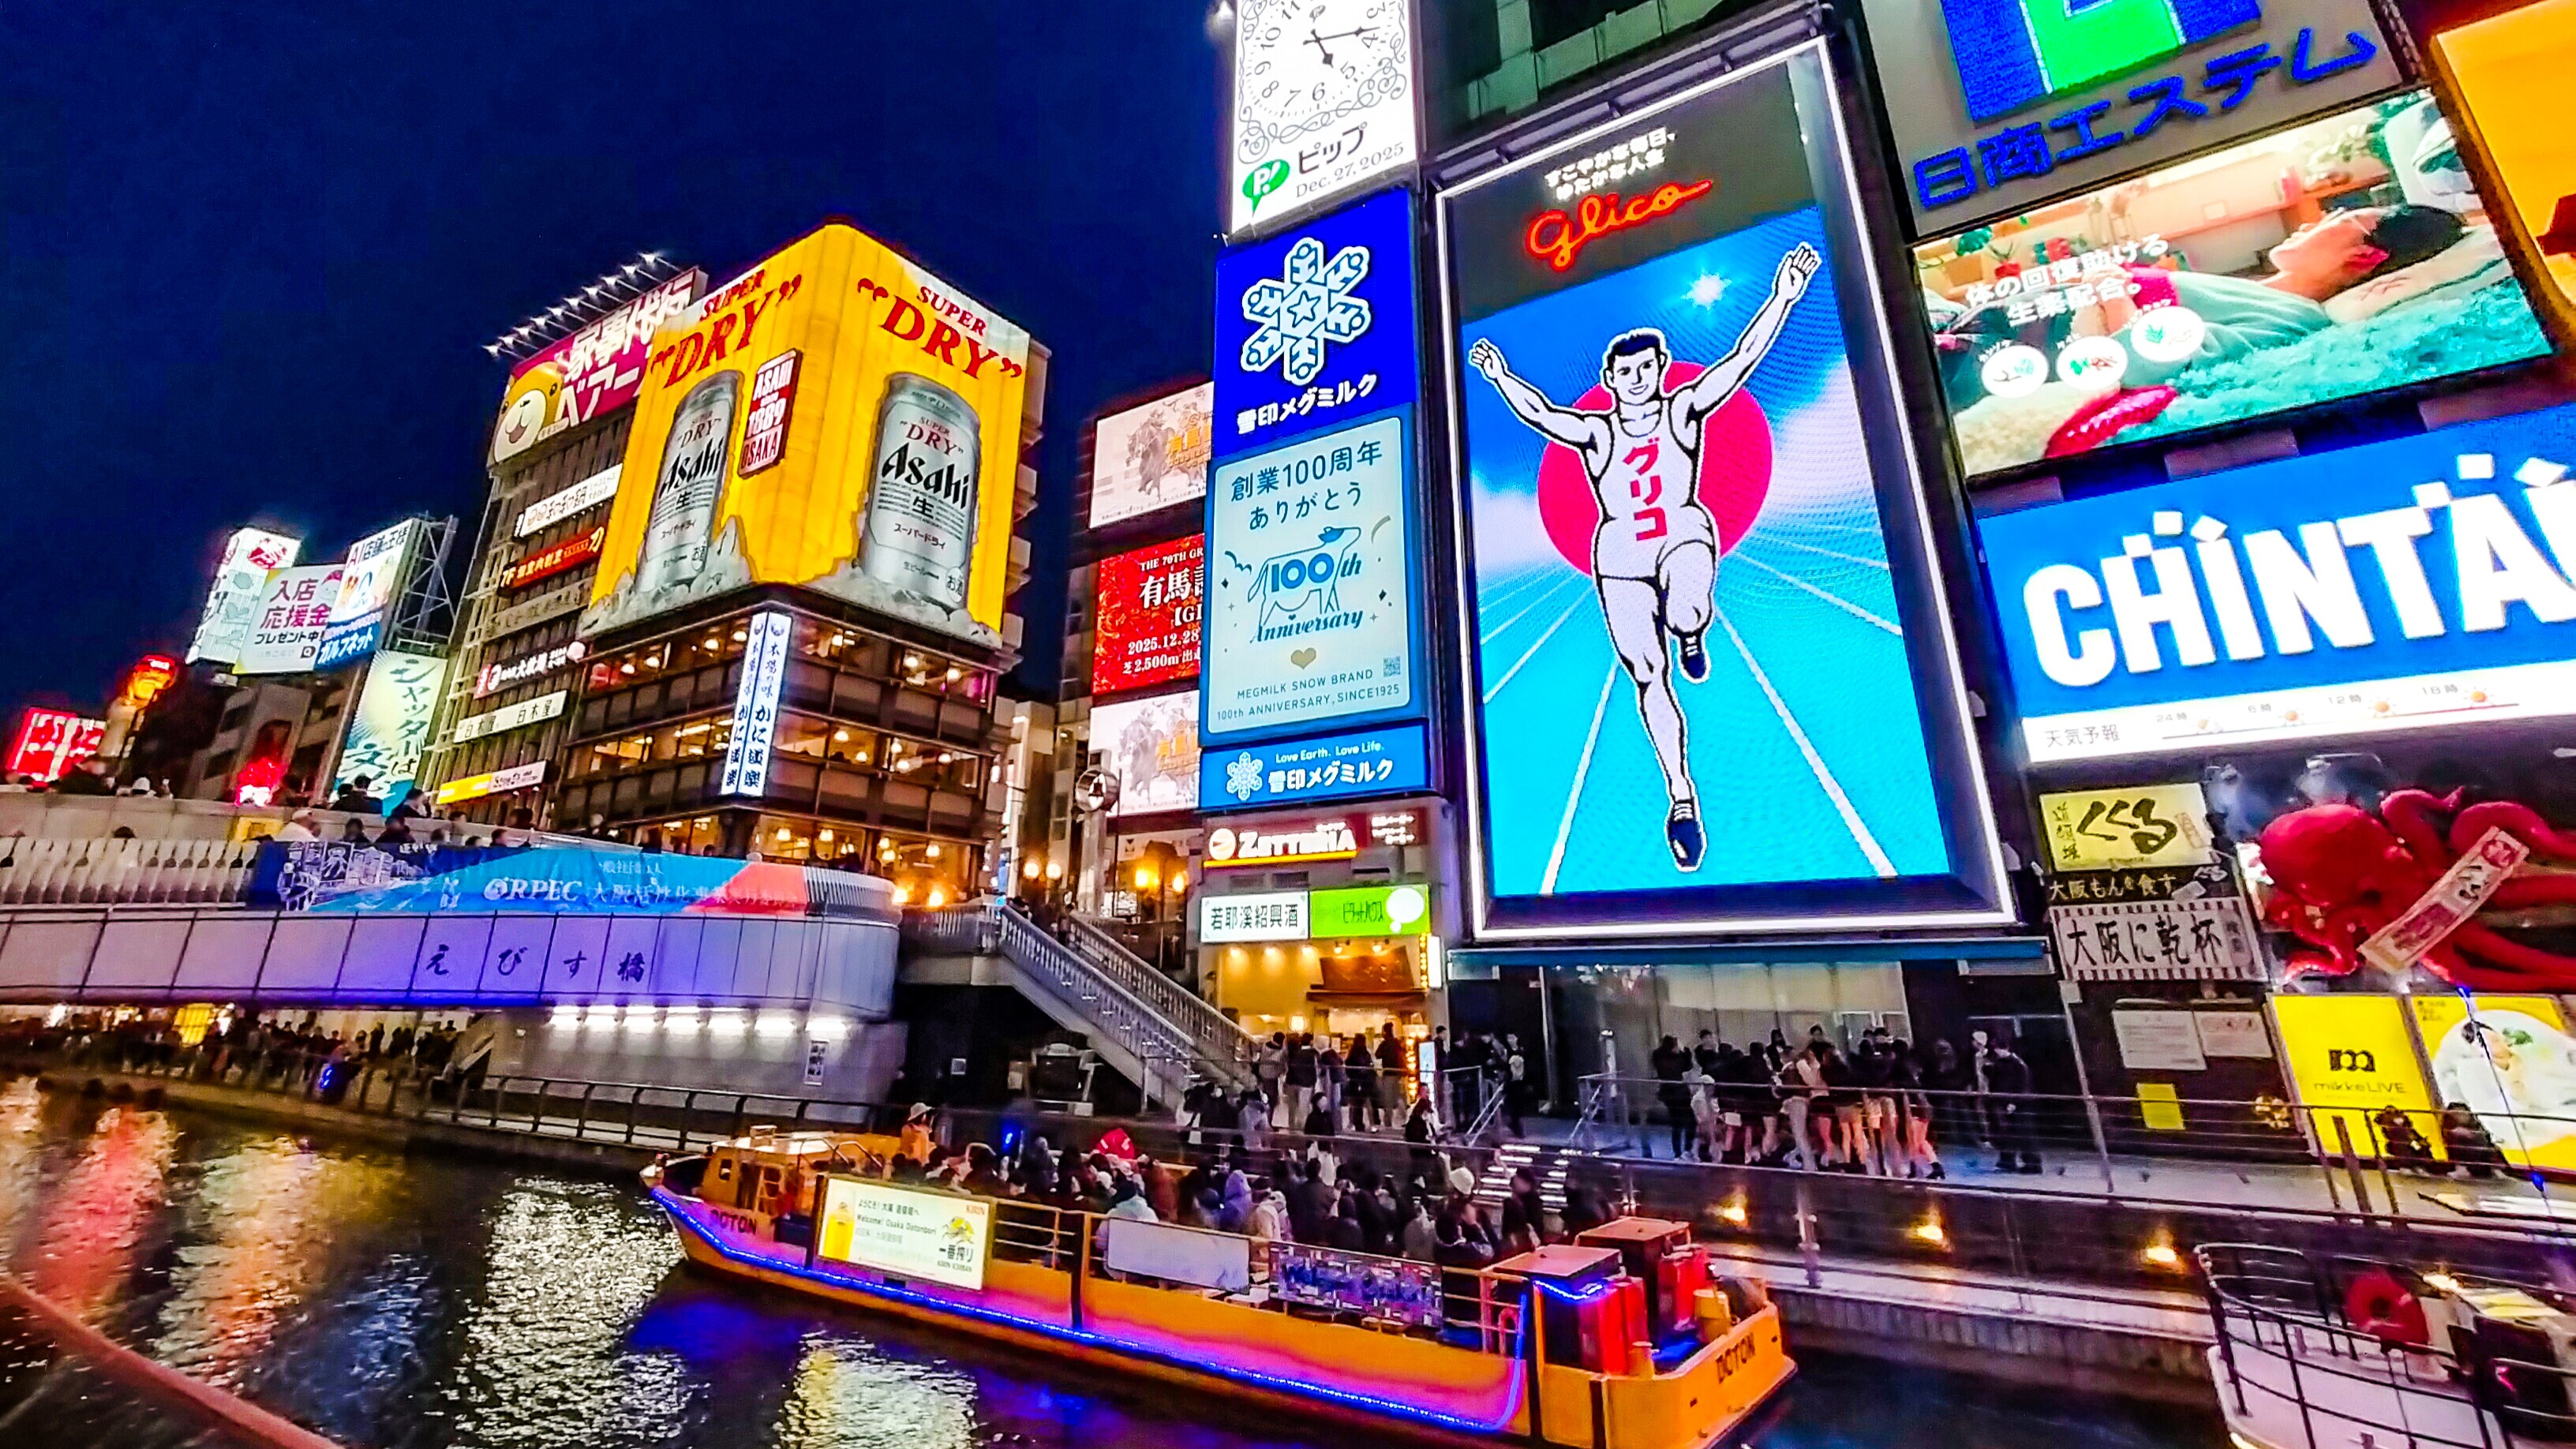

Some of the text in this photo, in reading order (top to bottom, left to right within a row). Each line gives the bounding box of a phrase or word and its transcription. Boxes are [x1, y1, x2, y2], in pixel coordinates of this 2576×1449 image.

[1260, 28, 1281, 50] 10
[1361, 33, 1379, 48] 4
[1255, 62, 1271, 75] 9
[1340, 61, 1355, 79] 5
[1262, 80, 1279, 98] 8
[1284, 89, 1301, 107] 7
[1312, 82, 1325, 101] 6
[1914, 28, 2377, 210] 日商エステム
[1299, 122, 1367, 174] ピップ
[1296, 141, 1404, 197] Dec. 27, 2025
[1965, 233, 2169, 307] 体の回復助ける
[700, 269, 765, 321] SUPER
[2007, 275, 2142, 328] 生薬配合。
[916, 286, 987, 337] SUPER
[564, 273, 693, 382] 家事代行
[555, 355, 649, 427] ベアー
[753, 359, 794, 401] ASAHI
[747, 398, 787, 437] 1889
[1237, 374, 1377, 434] 雪印メグミルク
[919, 417, 949, 434] SUPER
[741, 432, 777, 469] OSAKA
[658, 436, 724, 499] Asahi
[882, 442, 970, 509] Asahi
[1231, 440, 1382, 502] 創業100周年
[676, 492, 692, 510] 生
[1623, 436, 1667, 541] グリコ
[912, 496, 934, 519] 生
[1249, 481, 1361, 530] ありがとう
[893, 523, 945, 549] スーパードライ
[1140, 558, 1159, 571] THE
[1163, 552, 1186, 565] 70TH
[269, 578, 318, 602] 入店
[260, 603, 332, 629] 応援金
[1250, 610, 1363, 643] Anniversary
[318, 627, 373, 664] ガルフネット
[1129, 629, 1199, 655] 2025.12.28
[1237, 669, 1373, 699] MEGMILK SNOW BRAND
[517, 699, 552, 724] 白木屋
[1217, 709, 1244, 721] 100th
[1249, 696, 1335, 715] ANNIVERSARY,
[2045, 724, 2120, 747] 天気予報
[1276, 740, 1384, 763] Love Earth. Love Life.
[1268, 758, 1393, 793] 雪印メグミルク
[2076, 798, 2177, 855] くくる
[2067, 915, 2222, 965] 大阪に乾杯
[426, 945, 645, 983] えびす橋
[2315, 1082, 2406, 1094] mikkeLIVE
[886, 1219, 904, 1229] Osaka
[966, 1204, 985, 1215] KIRIN
[939, 1244, 973, 1262] 一番搾り
